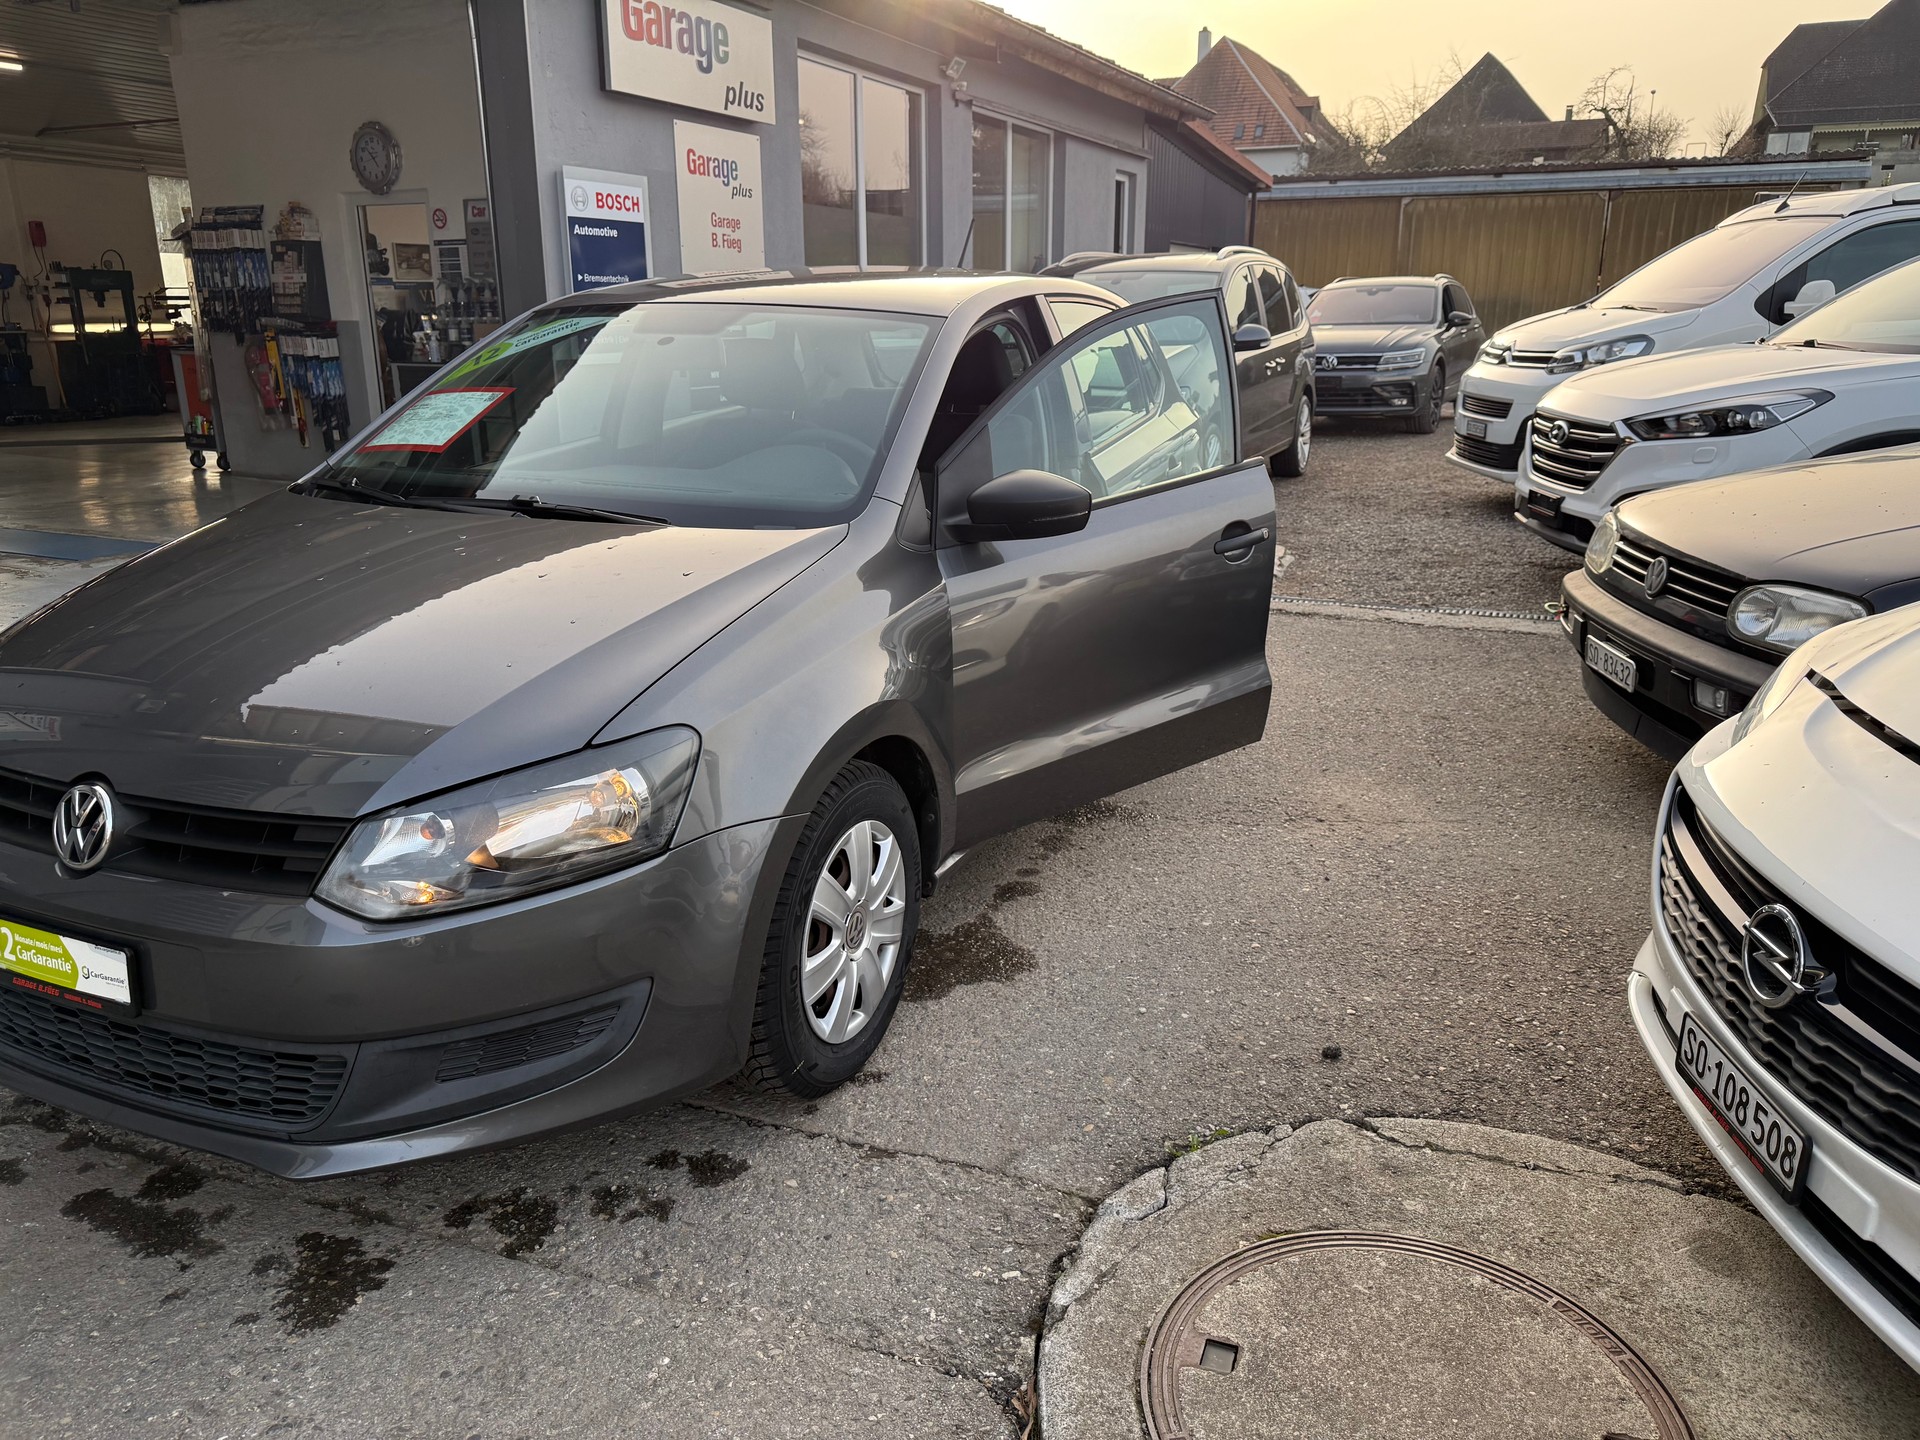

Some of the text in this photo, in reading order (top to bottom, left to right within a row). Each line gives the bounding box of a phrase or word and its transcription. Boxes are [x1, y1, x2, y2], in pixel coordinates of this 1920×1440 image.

[620, 0, 729, 74] Garage
[723, 81, 765, 112] plus
[686, 148, 739, 187] Garage
[731, 183, 753, 199] plus
[595, 191, 641, 213] BOSCH
[573, 224, 618, 238] Automotive
[710, 212, 741, 232] Garage
[711, 232, 742, 253] B. Füeg
[584, 273, 630, 284] Bremsentechnik
[16, 945, 72, 973] CarGarantie
[90, 970, 125, 984] CarGarantie
